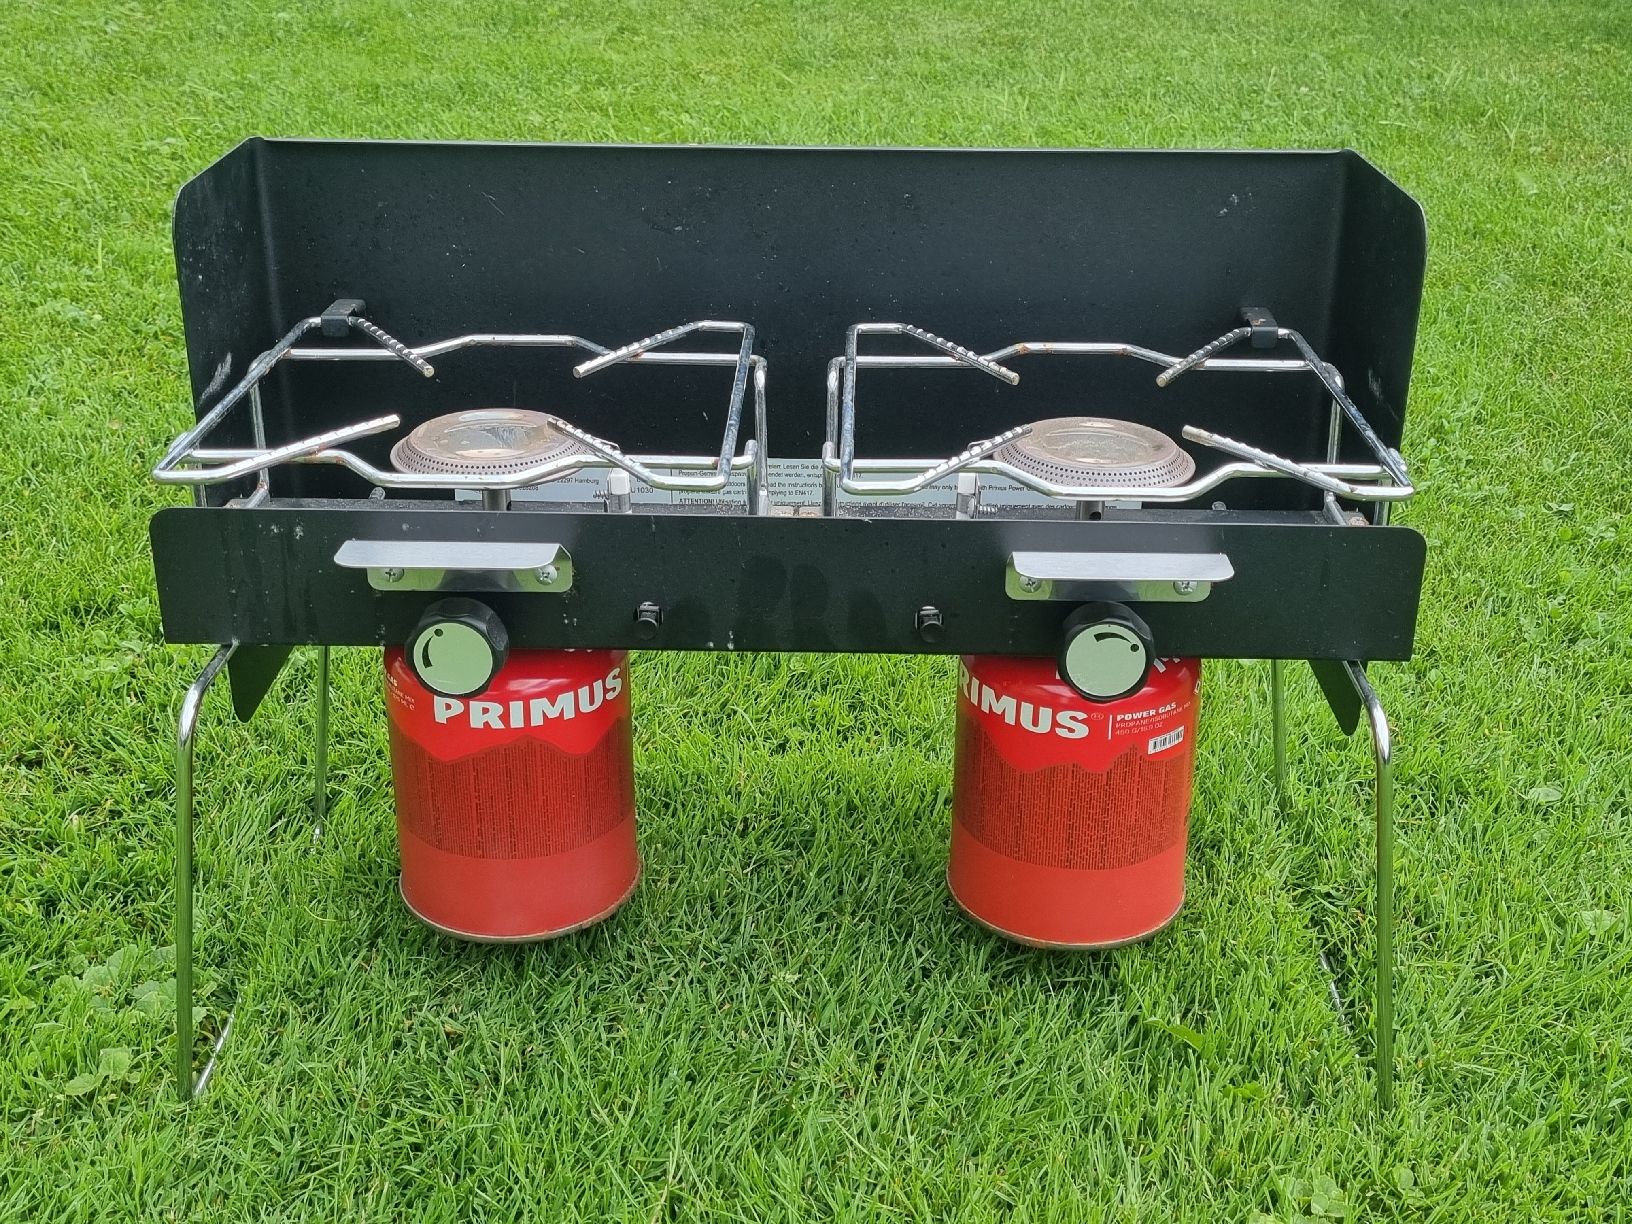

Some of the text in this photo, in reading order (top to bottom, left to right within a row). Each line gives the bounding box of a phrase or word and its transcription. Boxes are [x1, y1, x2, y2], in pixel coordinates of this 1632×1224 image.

[434, 667, 622, 728] PRIMUS
[958, 659, 1089, 739] RIMUS
[1116, 709, 1156, 721] POWER
[1158, 701, 1177, 714] GAS
